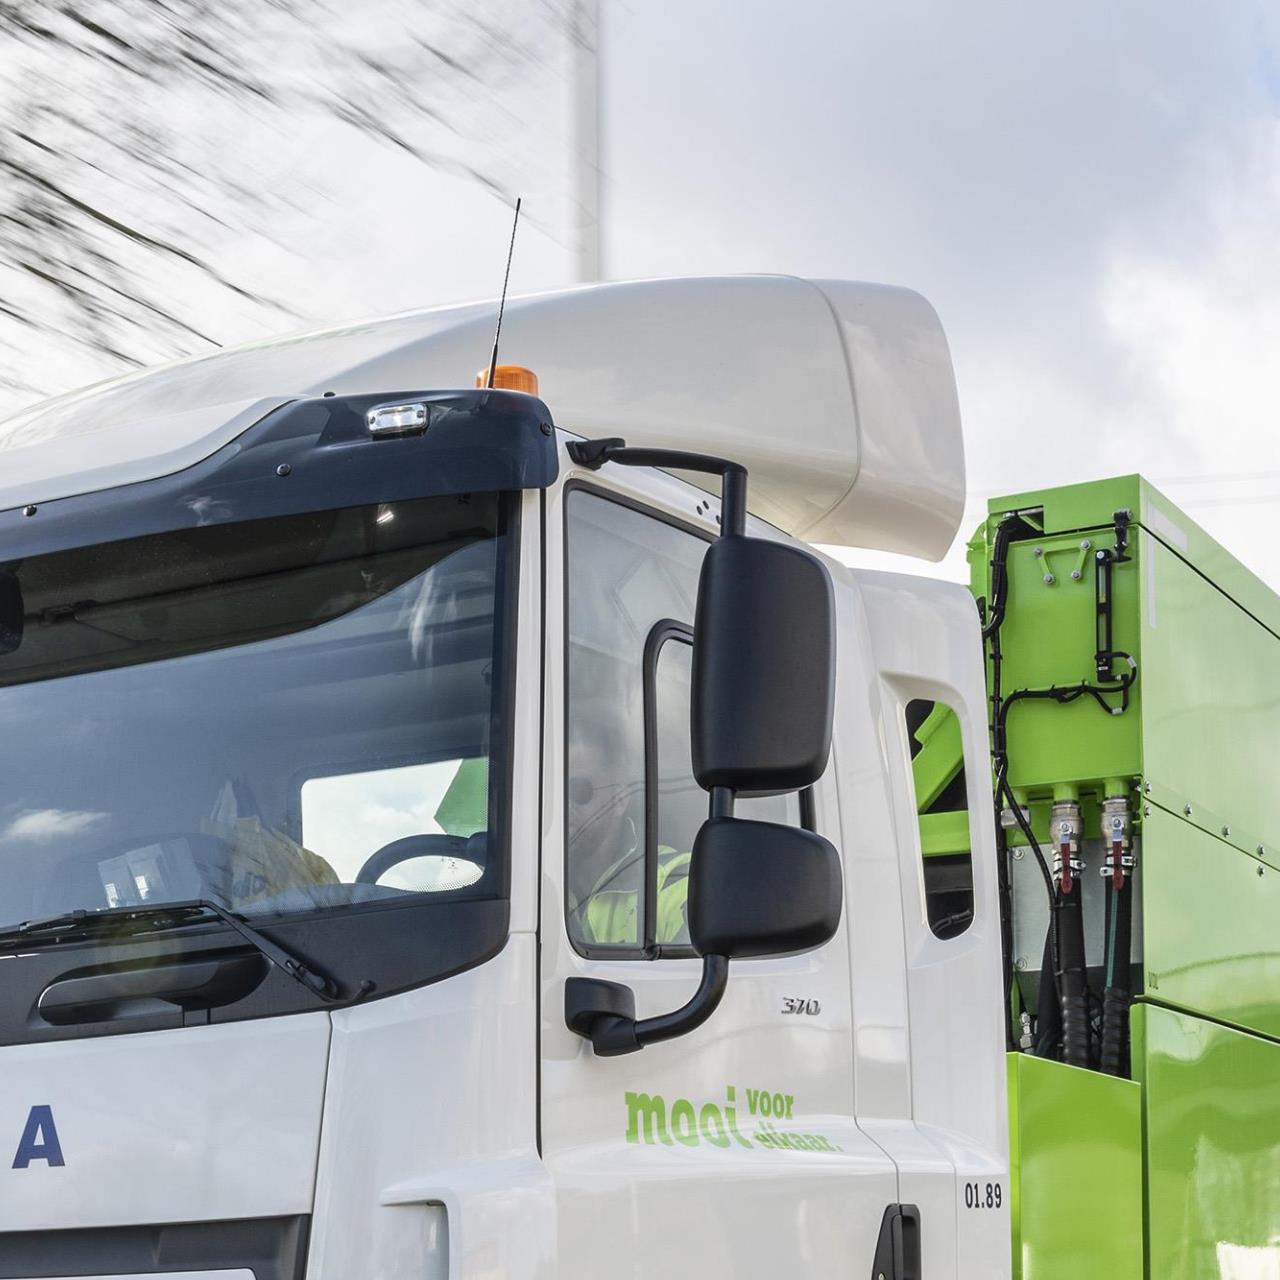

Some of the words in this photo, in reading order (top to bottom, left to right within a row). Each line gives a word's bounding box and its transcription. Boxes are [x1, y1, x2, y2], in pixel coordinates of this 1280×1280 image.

[781, 997, 821, 1015] 370
[625, 1086, 753, 1148] mooi
[746, 1089, 793, 1119] voor
[965, 1183, 1001, 1208] 01.89
